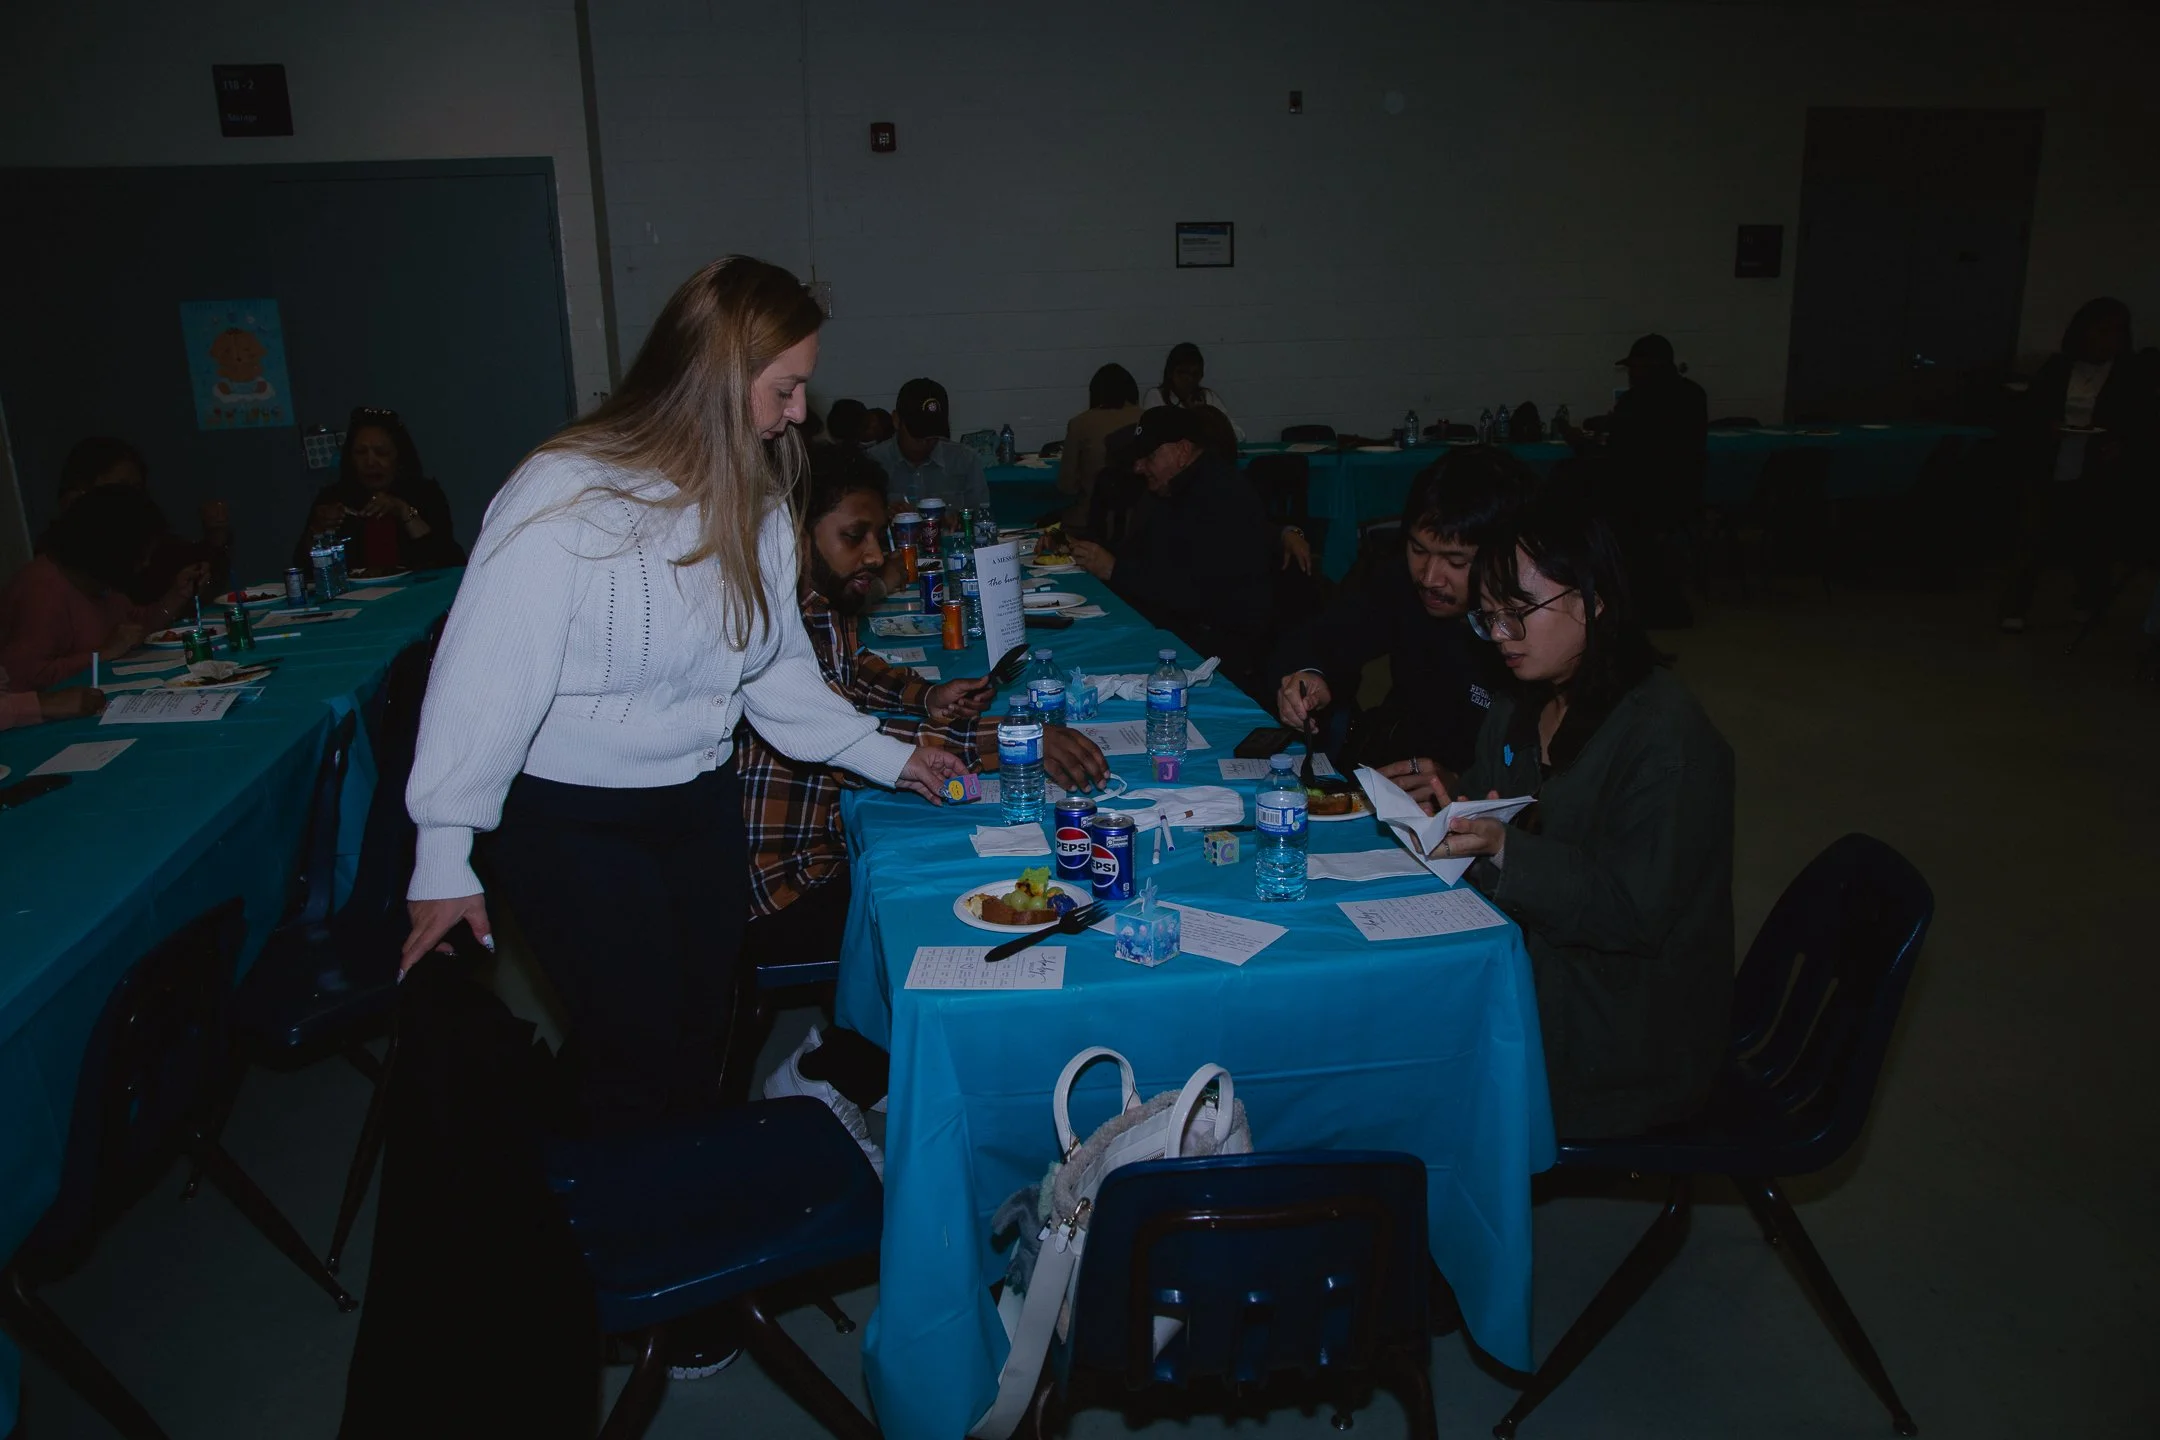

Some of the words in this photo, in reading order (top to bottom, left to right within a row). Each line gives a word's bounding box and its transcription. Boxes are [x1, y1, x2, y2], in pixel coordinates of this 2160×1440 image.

[987, 576, 1003, 587] the
[1162, 763, 1174, 781] J
[1056, 841, 1090, 853] PEPSI
[1220, 842, 1235, 863] C
[1091, 859, 1116, 873] EPSI
